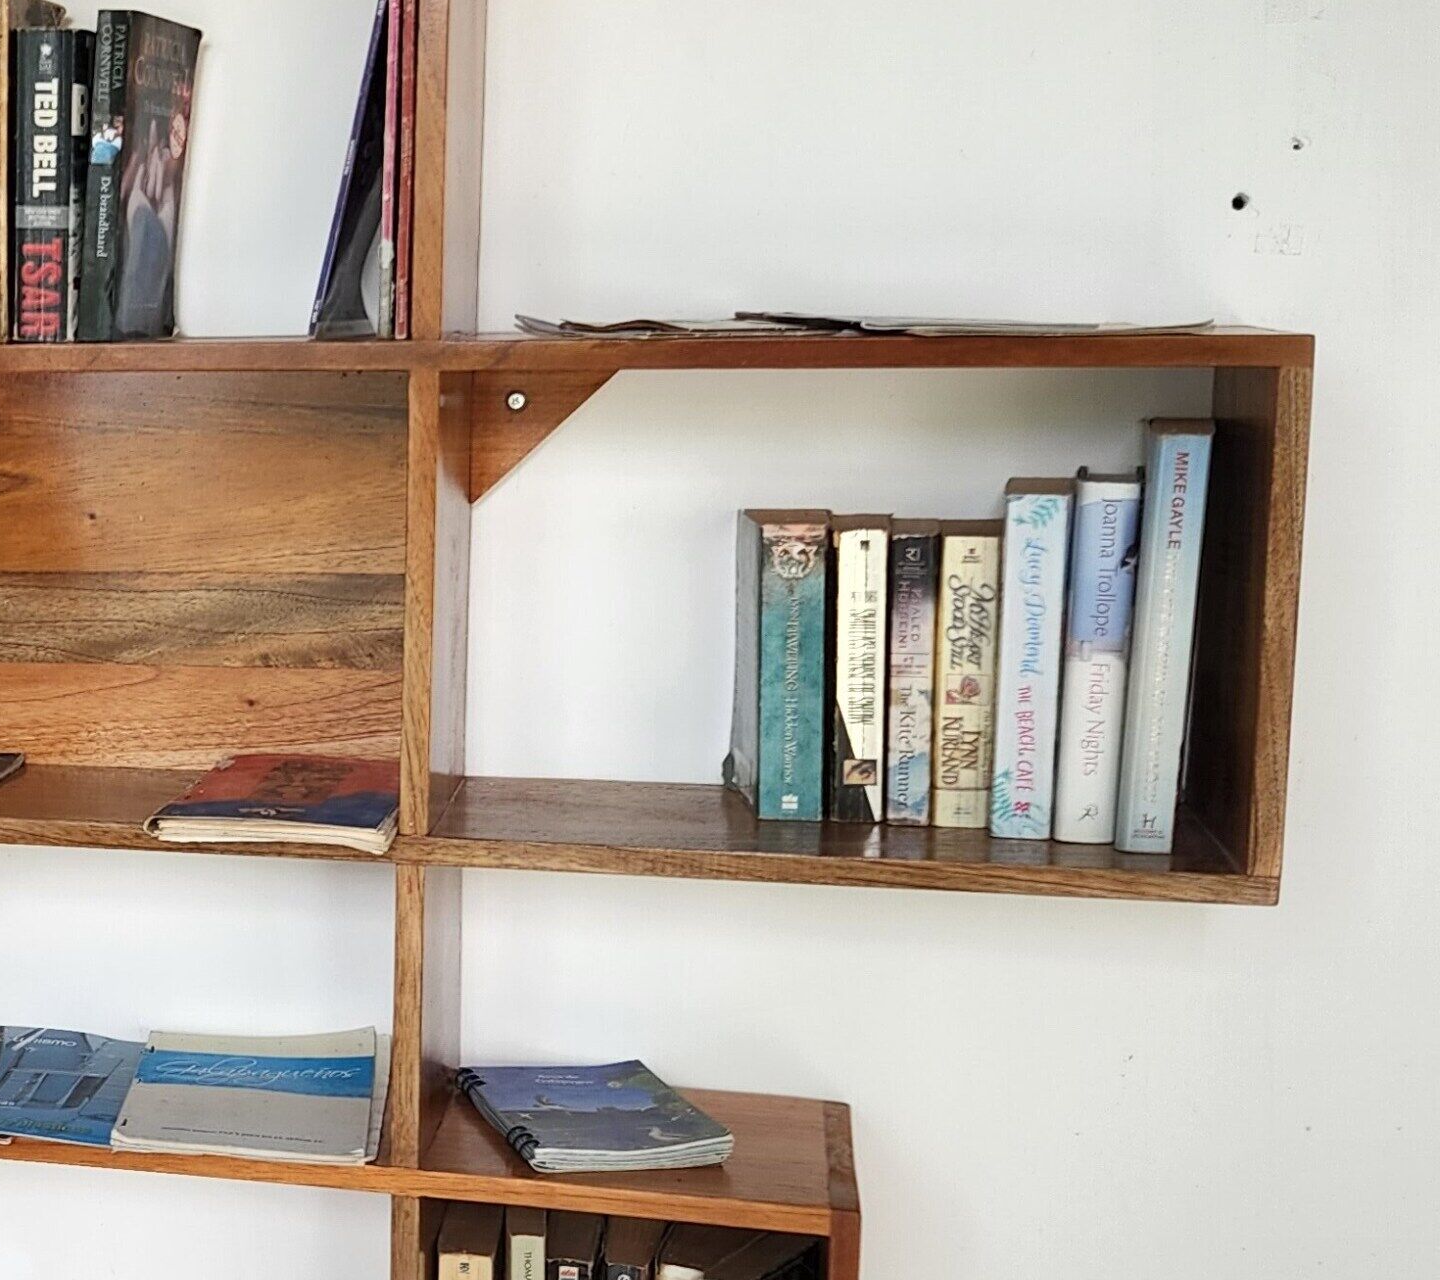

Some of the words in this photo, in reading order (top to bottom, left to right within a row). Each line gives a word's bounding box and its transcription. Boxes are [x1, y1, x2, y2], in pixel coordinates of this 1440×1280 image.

[97, 24, 113, 103] CORNWELL
[111, 23, 128, 91] PATRICIA
[33, 77, 60, 127] TED
[32, 133, 59, 199] BELL
[99, 175, 111, 193] De
[96, 195, 111, 258] brandhaard
[21, 236, 63, 337] TSAR
[1171, 451, 1190, 494] MIKE
[1099, 496, 1123, 559] Joanna
[1166, 496, 1187, 550] GAYLE
[1019, 538, 1047, 589] Lucy
[897, 581, 911, 649] HOSSEINI
[910, 587, 923, 642] KHALED
[1093, 564, 1121, 638] Trollope
[1019, 593, 1048, 677] Diamond
[900, 686, 913, 708] The
[1086, 661, 1112, 716] Friday
[783, 695, 799, 739] Hidden
[899, 710, 918, 747] Kite
[781, 740, 798, 785] Warrior
[941, 715, 963, 785] KURLAND
[961, 730, 981, 770] LYNN
[1080, 719, 1106, 777] Nights
[897, 750, 914, 808] Runner
